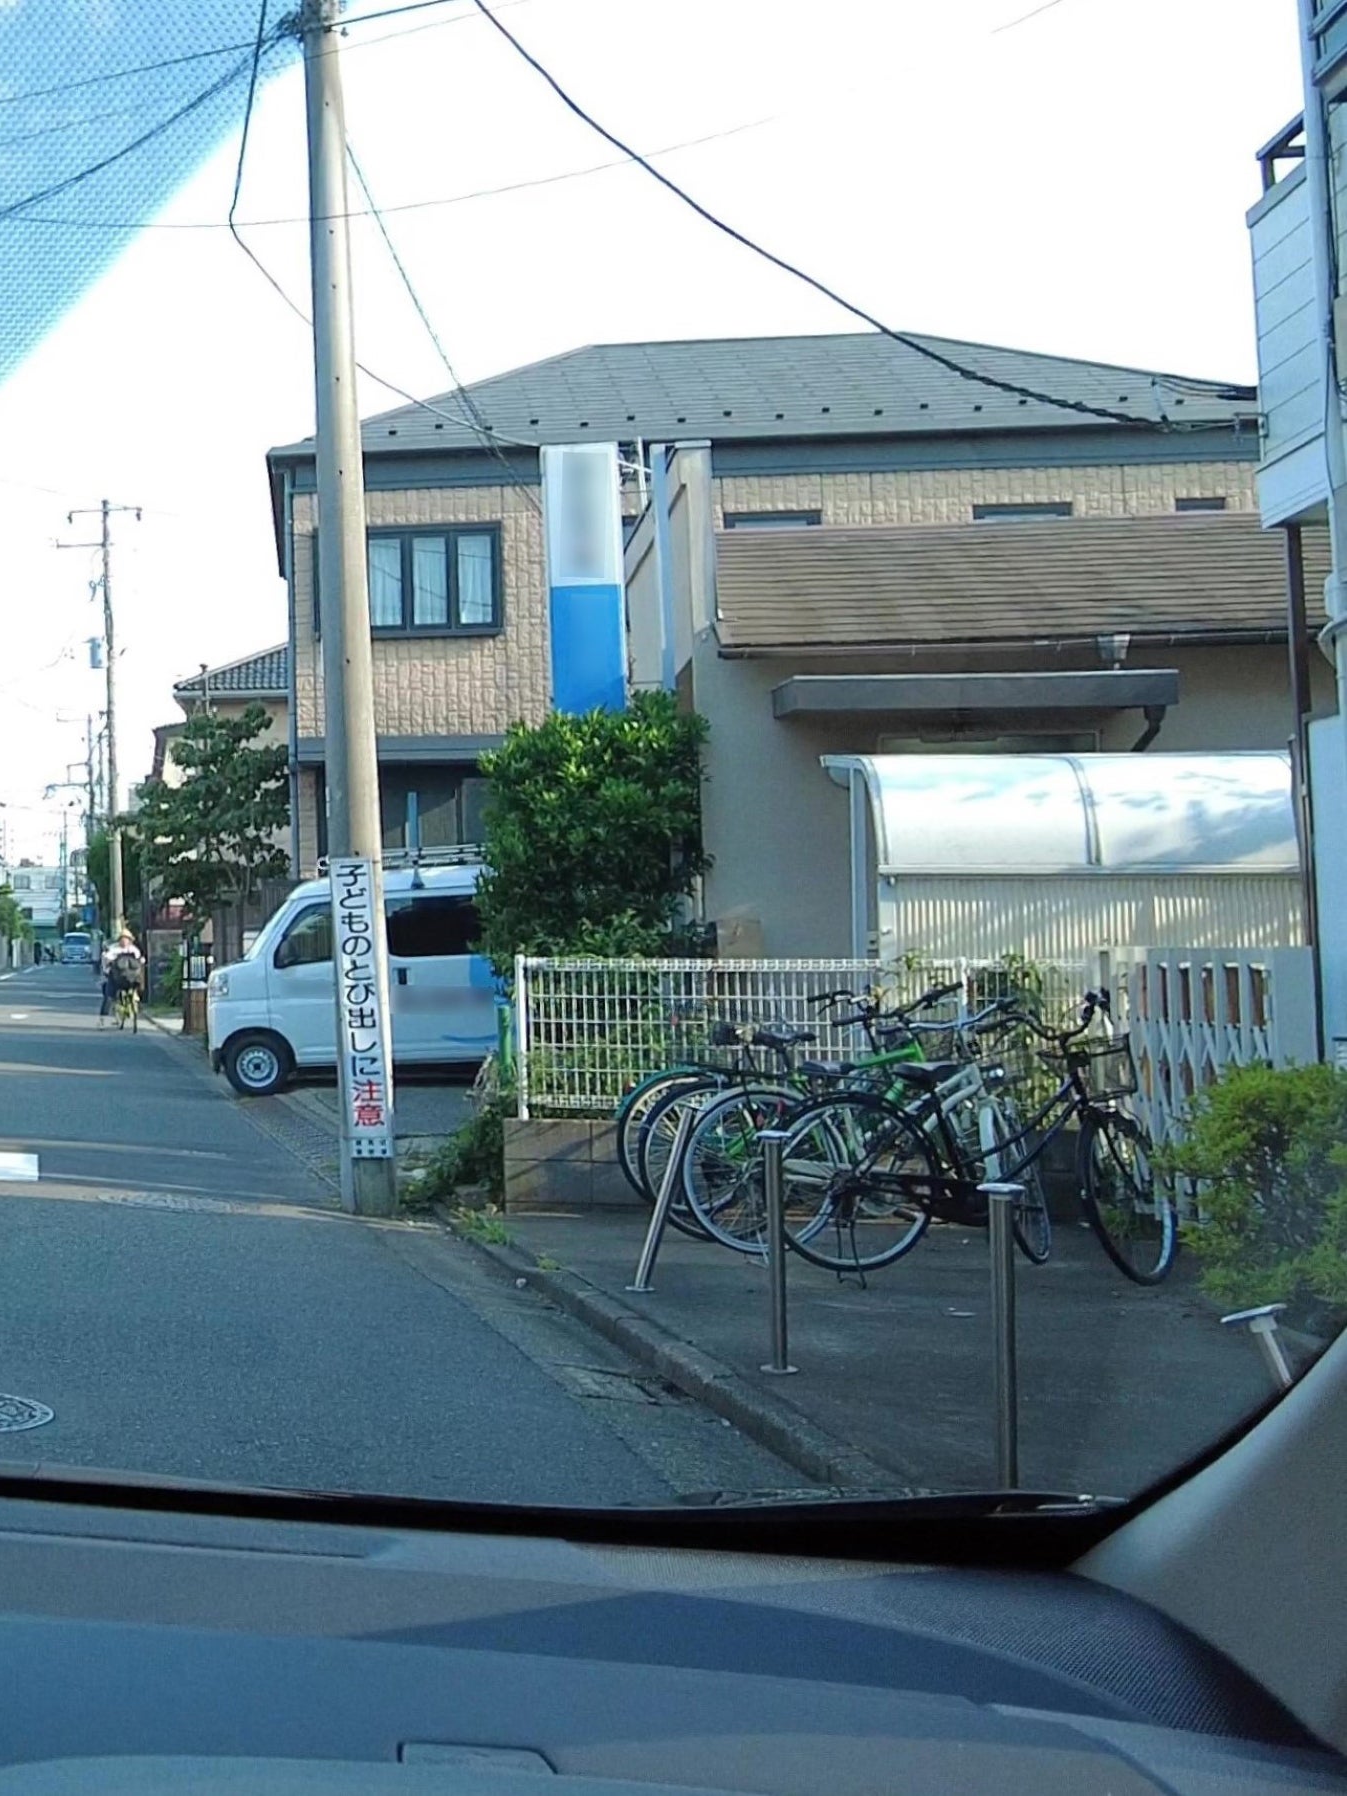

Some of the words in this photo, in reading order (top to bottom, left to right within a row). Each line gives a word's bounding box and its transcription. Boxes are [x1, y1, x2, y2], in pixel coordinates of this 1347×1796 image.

[336, 864, 385, 1127] 子どものとび出しに注意
